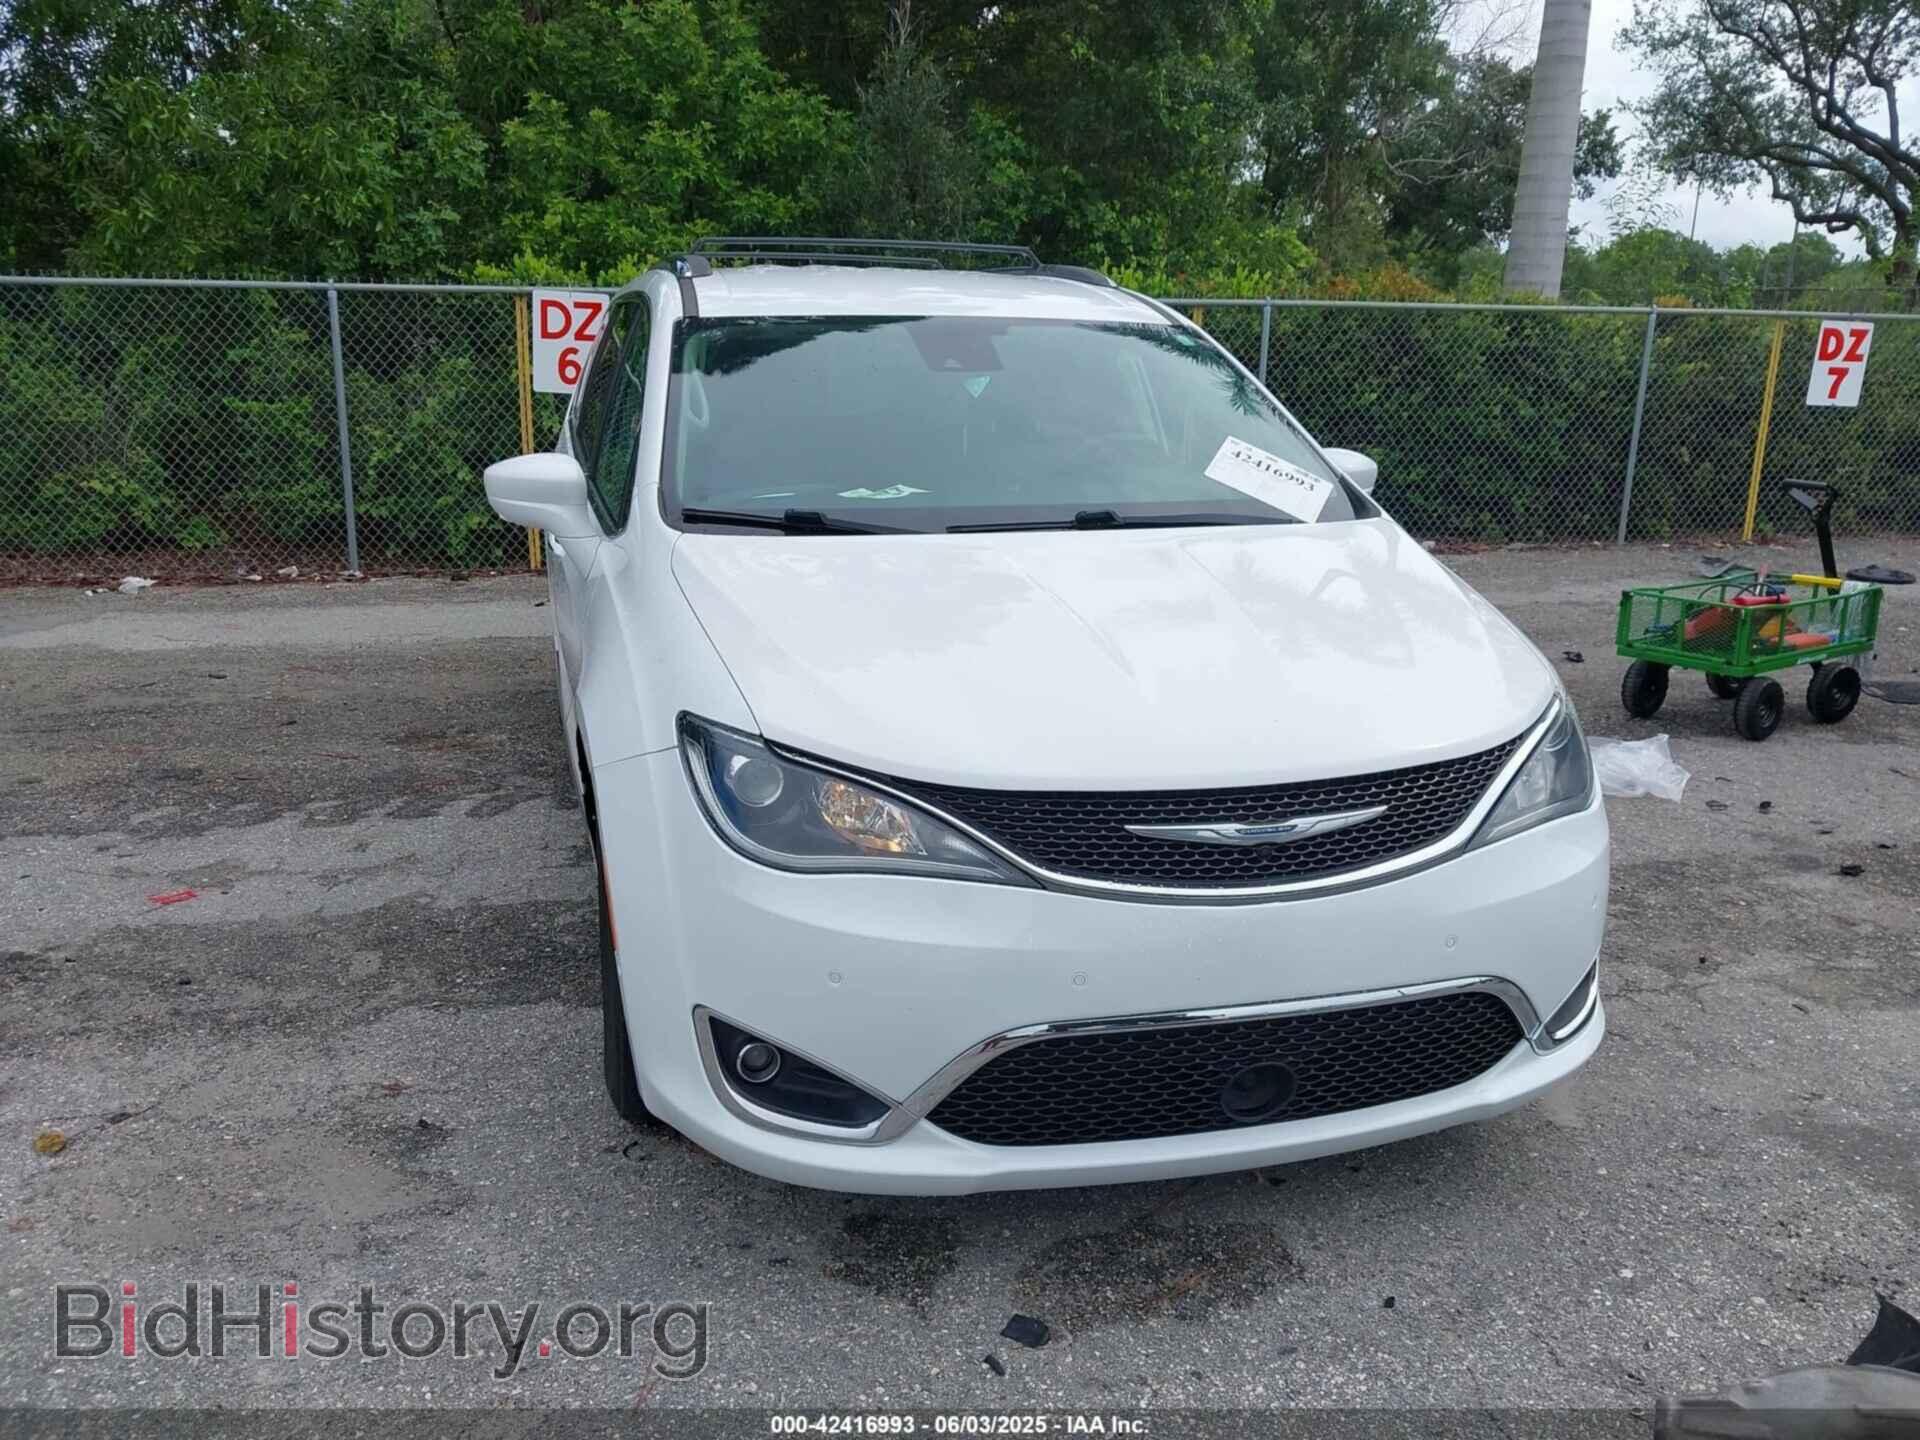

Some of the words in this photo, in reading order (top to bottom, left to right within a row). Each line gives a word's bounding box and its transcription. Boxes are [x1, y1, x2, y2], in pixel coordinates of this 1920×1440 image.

[540, 299, 602, 341] DZ
[1818, 327, 1870, 362] DZ
[558, 347, 582, 385] 6
[1827, 367, 1850, 399] 7
[1232, 450, 1315, 492] 42416993
